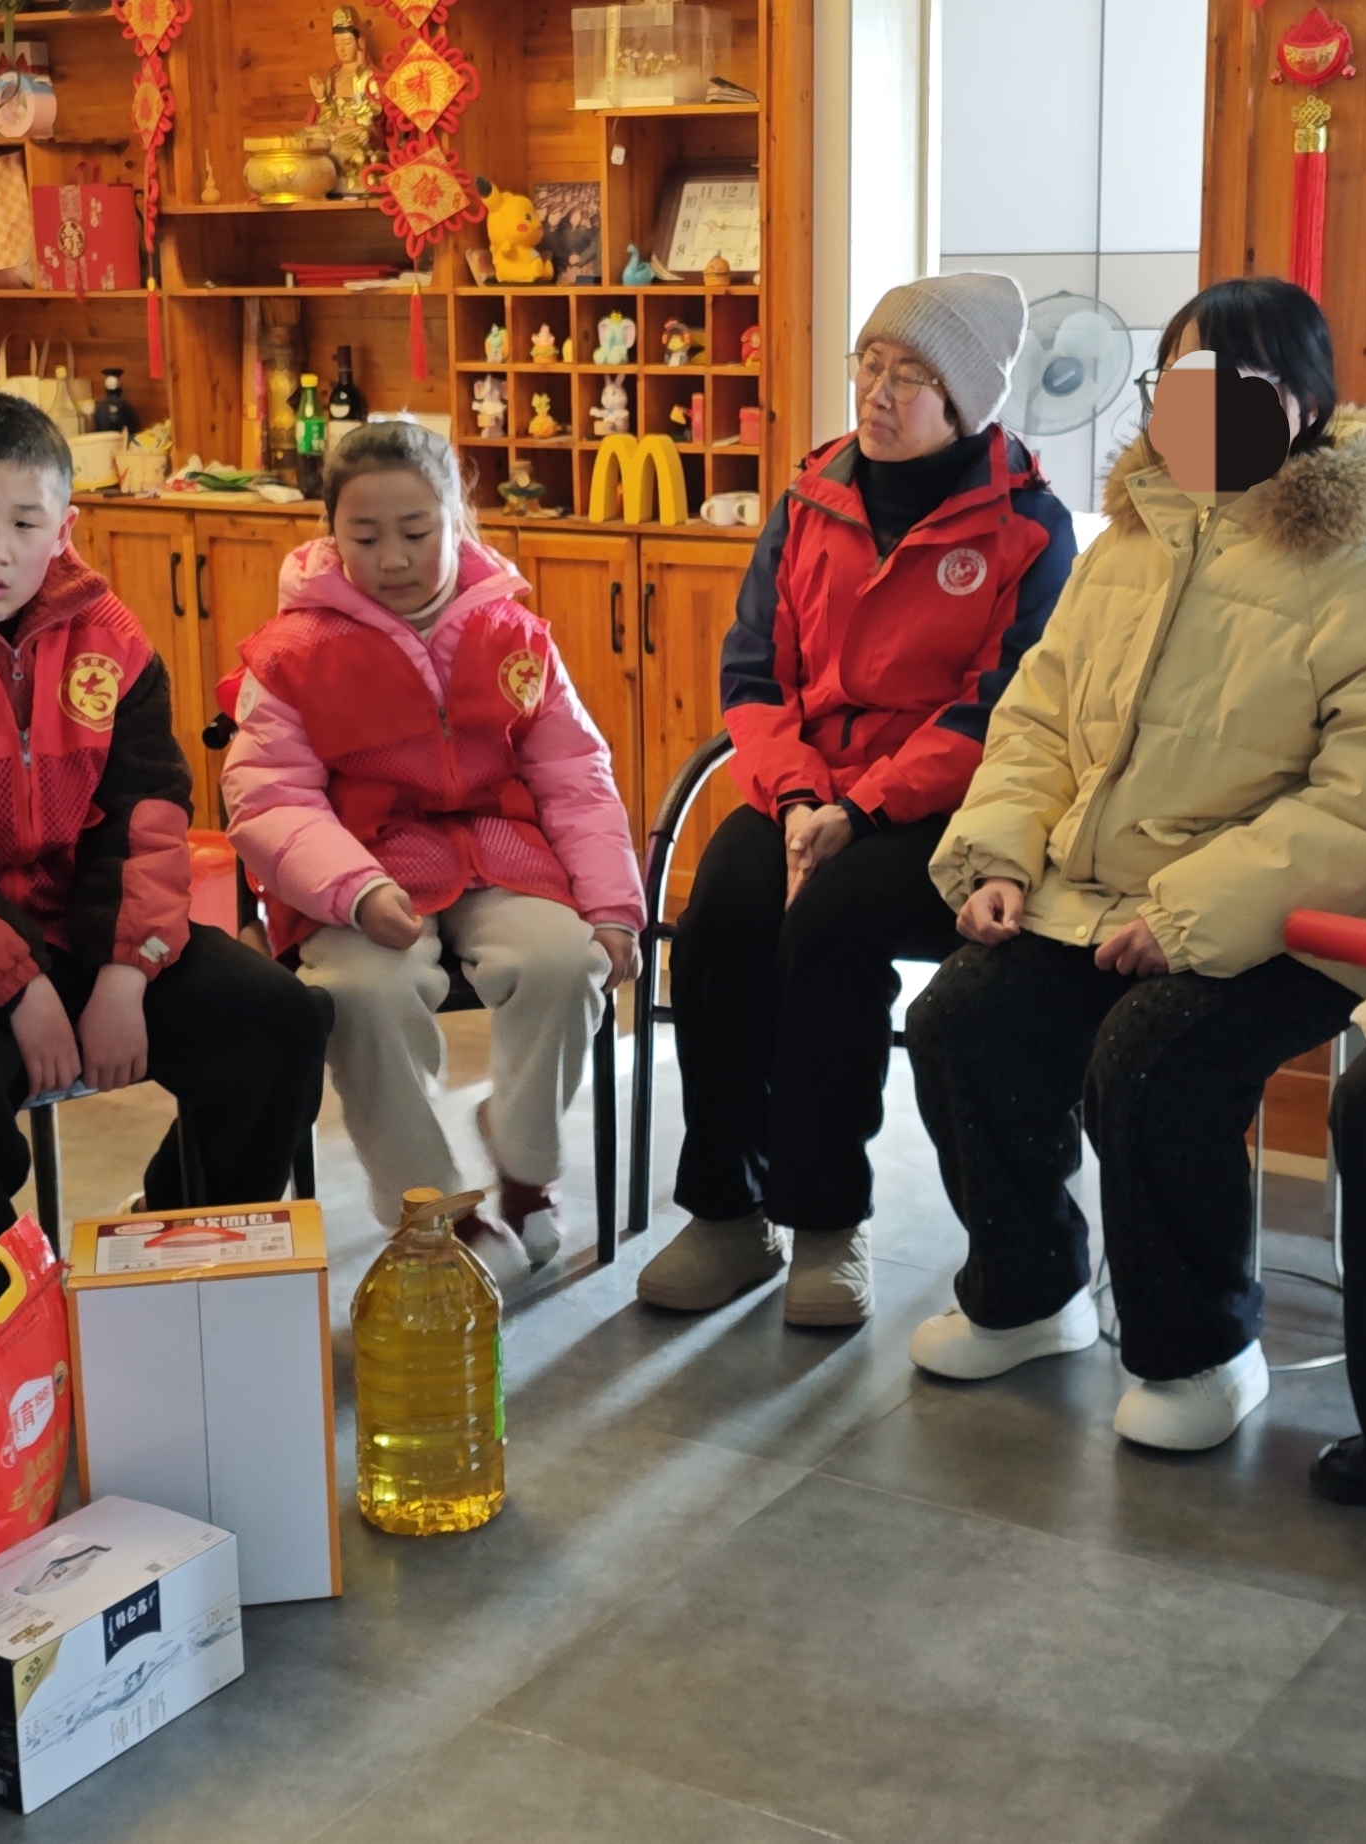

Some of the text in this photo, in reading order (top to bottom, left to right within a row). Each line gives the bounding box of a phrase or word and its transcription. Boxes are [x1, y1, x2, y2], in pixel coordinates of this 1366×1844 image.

[701, 185, 713, 199] 11
[721, 185, 739, 199] 12
[680, 219, 691, 233] 9
[676, 244, 687, 257] 8
[733, 253, 744, 268] 5
[110, 1691, 167, 1748] 纯牛奶
